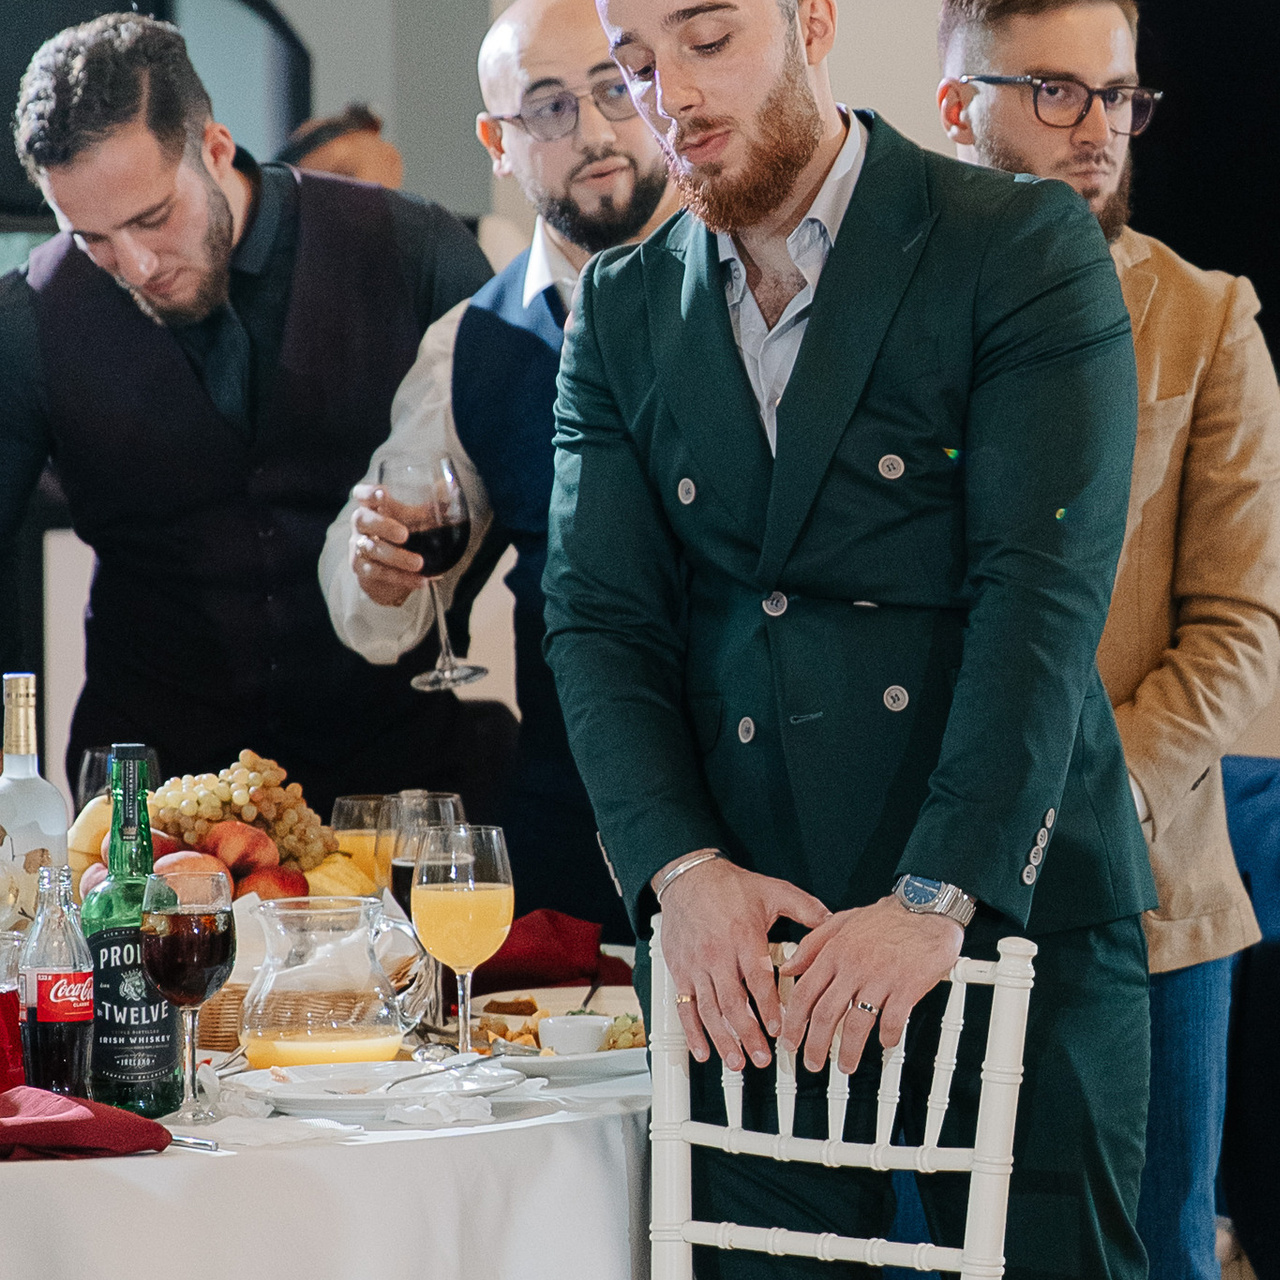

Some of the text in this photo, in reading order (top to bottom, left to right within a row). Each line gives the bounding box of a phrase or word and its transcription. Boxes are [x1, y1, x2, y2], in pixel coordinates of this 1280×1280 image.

[99, 943, 142, 970] PRO
[101, 1000, 169, 1025] TWELVE
[99, 1034, 171, 1044] IRISH WHISKEY
